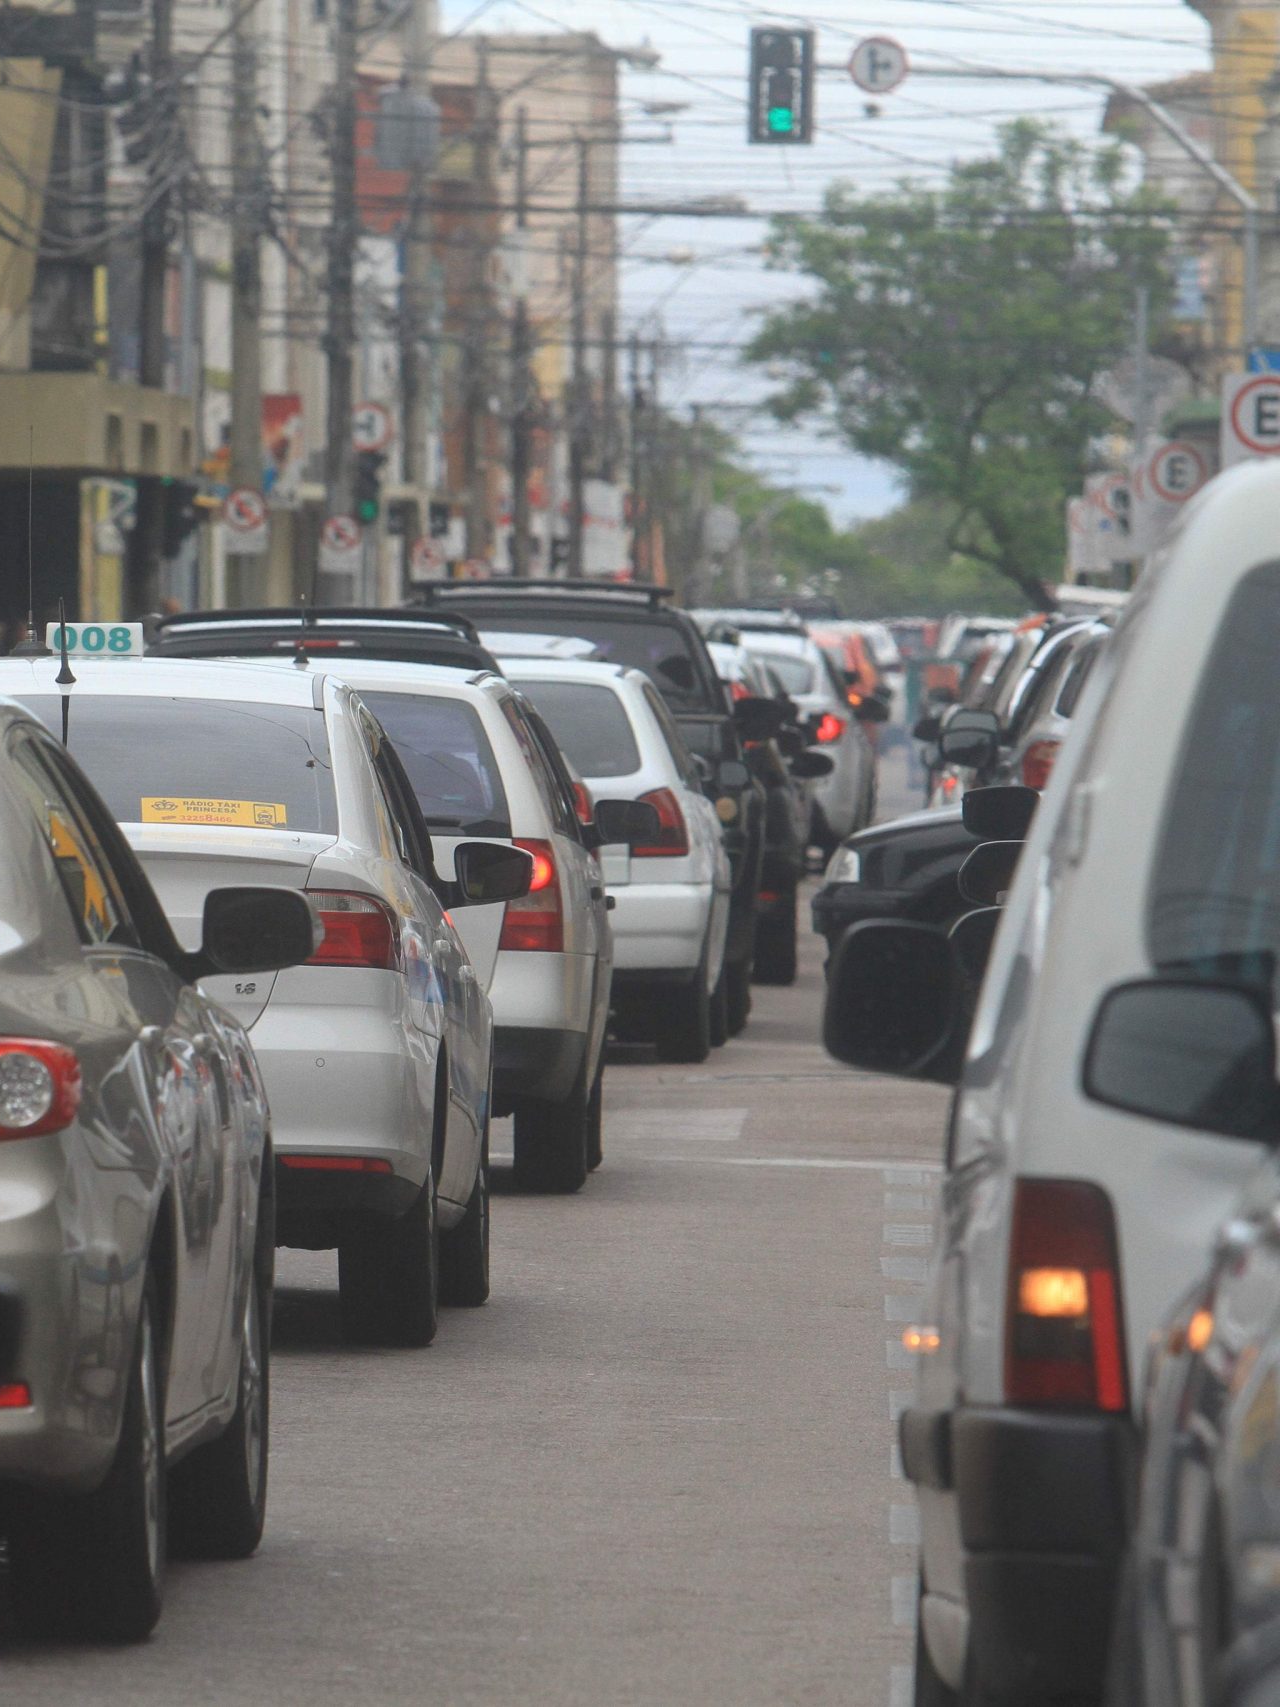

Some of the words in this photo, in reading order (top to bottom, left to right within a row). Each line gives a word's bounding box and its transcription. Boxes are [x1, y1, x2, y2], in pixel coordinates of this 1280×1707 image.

[1255, 395, 1280, 436] E
[53, 626, 132, 652] 008
[186, 806, 238, 814] PRINCESA
